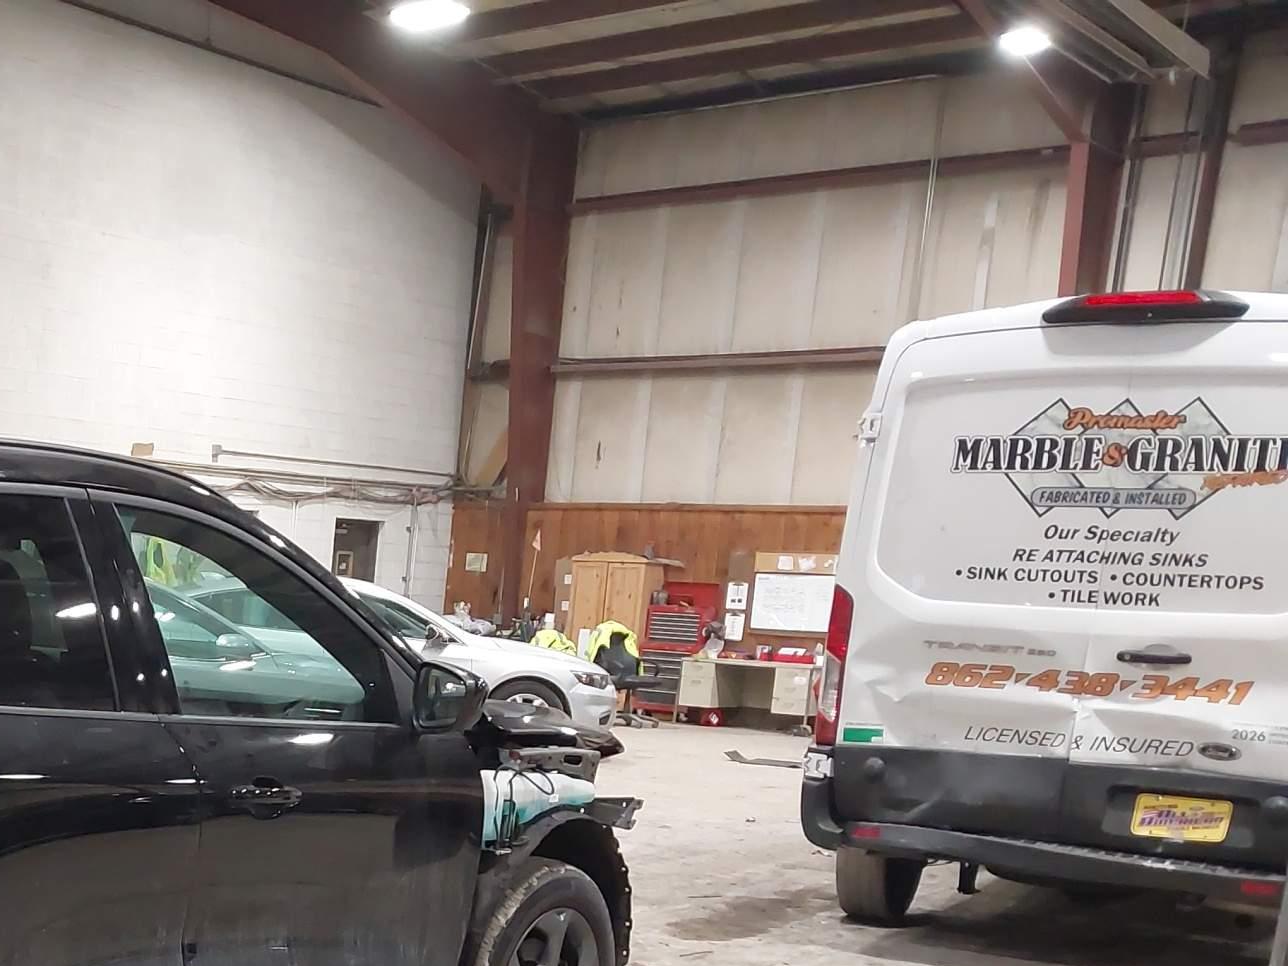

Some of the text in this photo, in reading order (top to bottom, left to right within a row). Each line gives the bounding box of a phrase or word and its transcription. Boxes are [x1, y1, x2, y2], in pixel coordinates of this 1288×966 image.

[952, 436, 1103, 472] MARBLE
[1039, 490, 1187, 506] FABRICATED & INSTALLED
[1043, 523, 1181, 546] Our Specialty
[1012, 548, 1209, 568] RE ATTACHING SINKS
[966, 566, 1265, 591] SINK CUTOUTS COUNTERTOPS
[1060, 589, 1161, 607] TILE WORK
[923, 640, 1025, 655] TRANSIT
[964, 725, 1066, 748] LICENSED
[1071, 735, 1083, 751] &
[1089, 736, 1194, 757] INSURED
[1232, 728, 1266, 742] 2026
